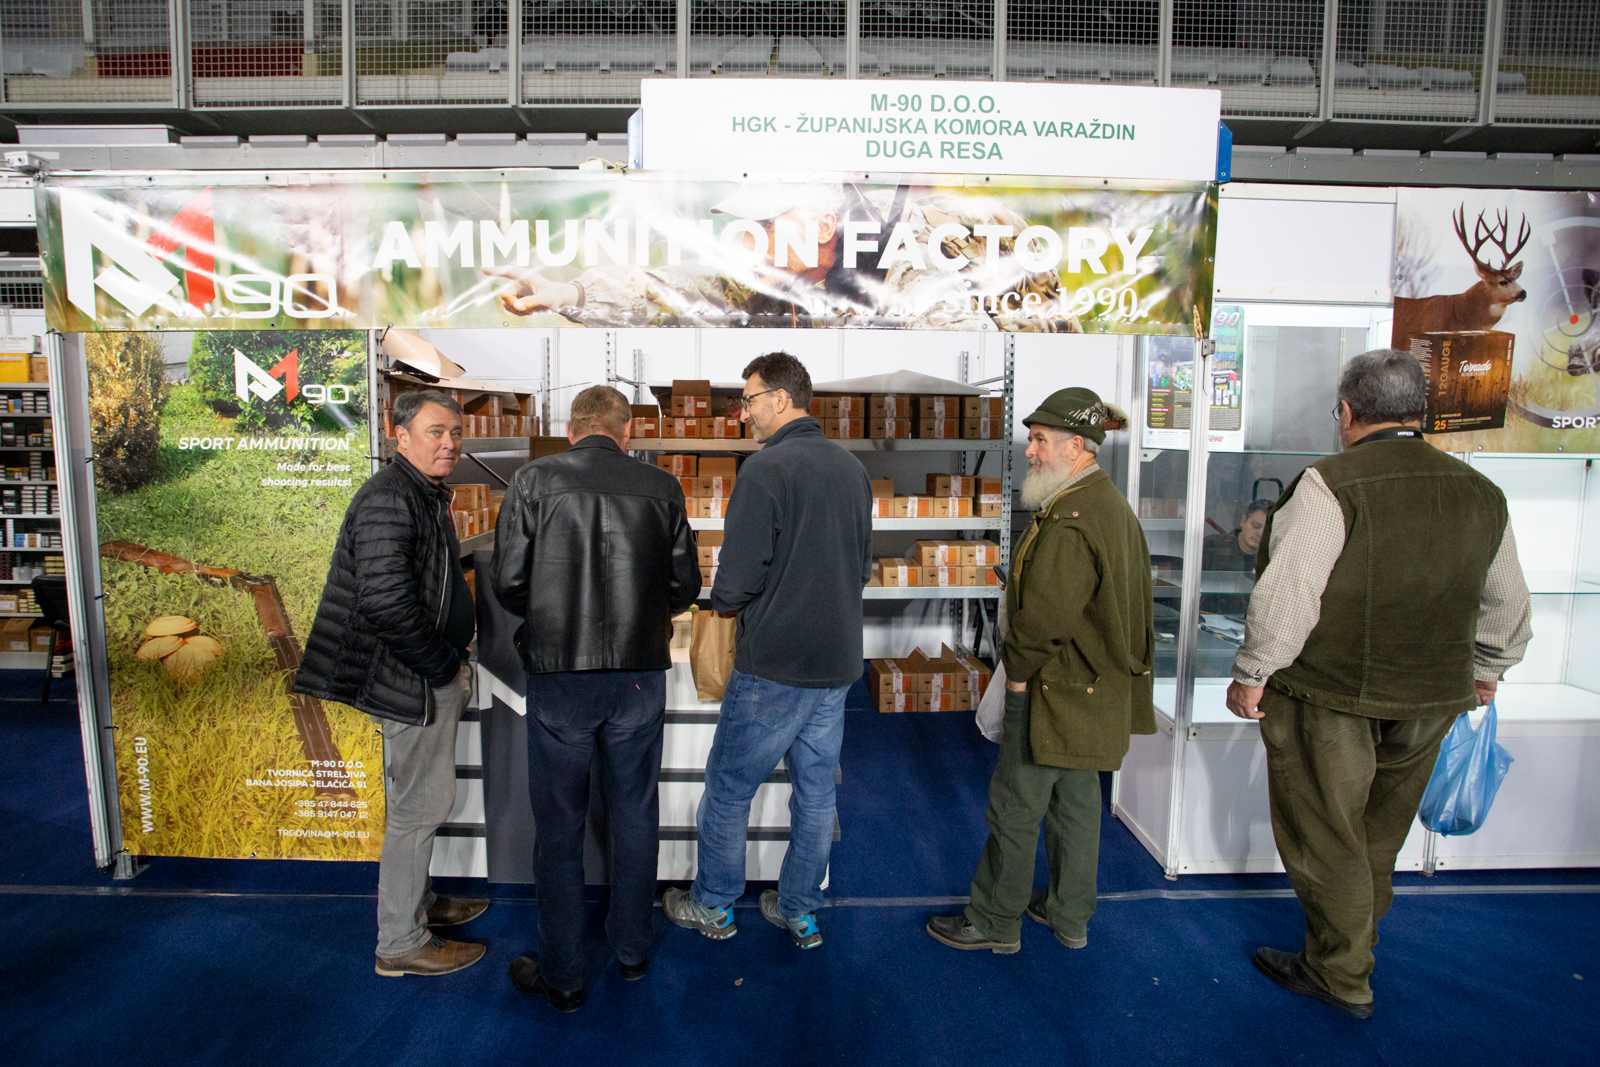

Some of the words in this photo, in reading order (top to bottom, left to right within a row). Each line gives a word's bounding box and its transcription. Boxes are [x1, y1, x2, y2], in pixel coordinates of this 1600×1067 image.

[870, 93, 922, 112] M-90
[930, 94, 1001, 113] D.O.O.
[732, 116, 777, 132] HGK
[796, 112, 928, 134] ŽUPANIJSKA
[934, 118, 1028, 136] KOMORA
[1033, 118, 1135, 140] VARAŽDIN
[866, 140, 934, 158] DUGA
[940, 141, 1004, 160] RESA
[372, 218, 819, 268] AMMUNITION
[843, 222, 1154, 275] FACTORY
[943, 281, 1042, 317] since
[1056, 286, 1149, 318] 1990.
[1459, 360, 1492, 373] Tornado
[1434, 420, 1447, 430] 25
[178, 437, 235, 450] SPORT
[237, 437, 350, 450] AMMUNITION
[277, 462, 306, 472] Made
[308, 462, 325, 472] for
[326, 462, 351, 472] best
[261, 476, 308, 488] shooting
[310, 477, 352, 487] results!
[311, 760, 336, 768] M-90
[338, 761, 366, 769] D.O.O.
[267, 769, 315, 778] TVORNICA
[316, 770, 367, 779] STRELJIVA
[134, 737, 154, 833] WWW.M-90.EU
[246, 779, 273, 787] BANA
[274, 779, 309, 788] JOSIPA
[310, 780, 355, 789] JELAČIĆA
[357, 781, 367, 789] 51
[294, 800, 316, 808] +385
[317, 800, 329, 808] 47
[350, 801, 368, 809] 625
[294, 810, 316, 818] +385
[340, 811, 357, 819] 047
[358, 811, 369, 819] 12
[277, 829, 370, 839] TRGOVINA@M-90.EU
